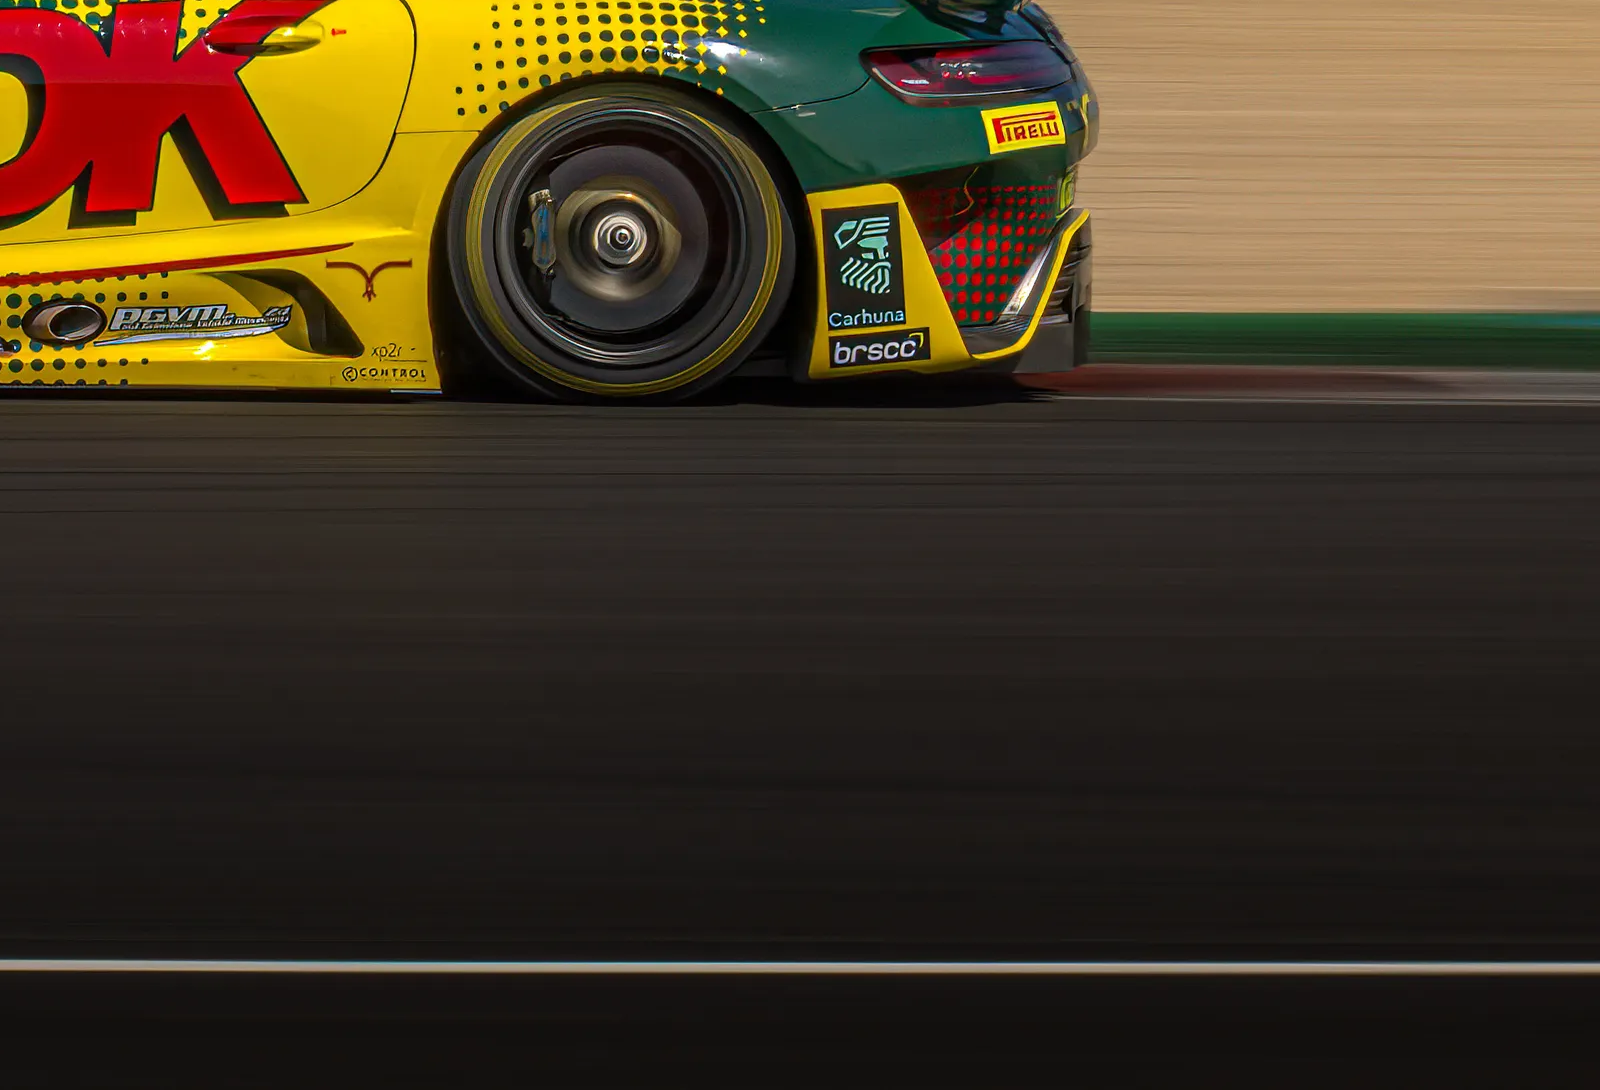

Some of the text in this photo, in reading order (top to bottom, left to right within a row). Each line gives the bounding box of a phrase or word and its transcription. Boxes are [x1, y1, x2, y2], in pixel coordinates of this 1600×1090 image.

[992, 111, 1060, 144] PIRELLI
[829, 308, 904, 327] Carhuna
[833, 340, 917, 365] brscc
